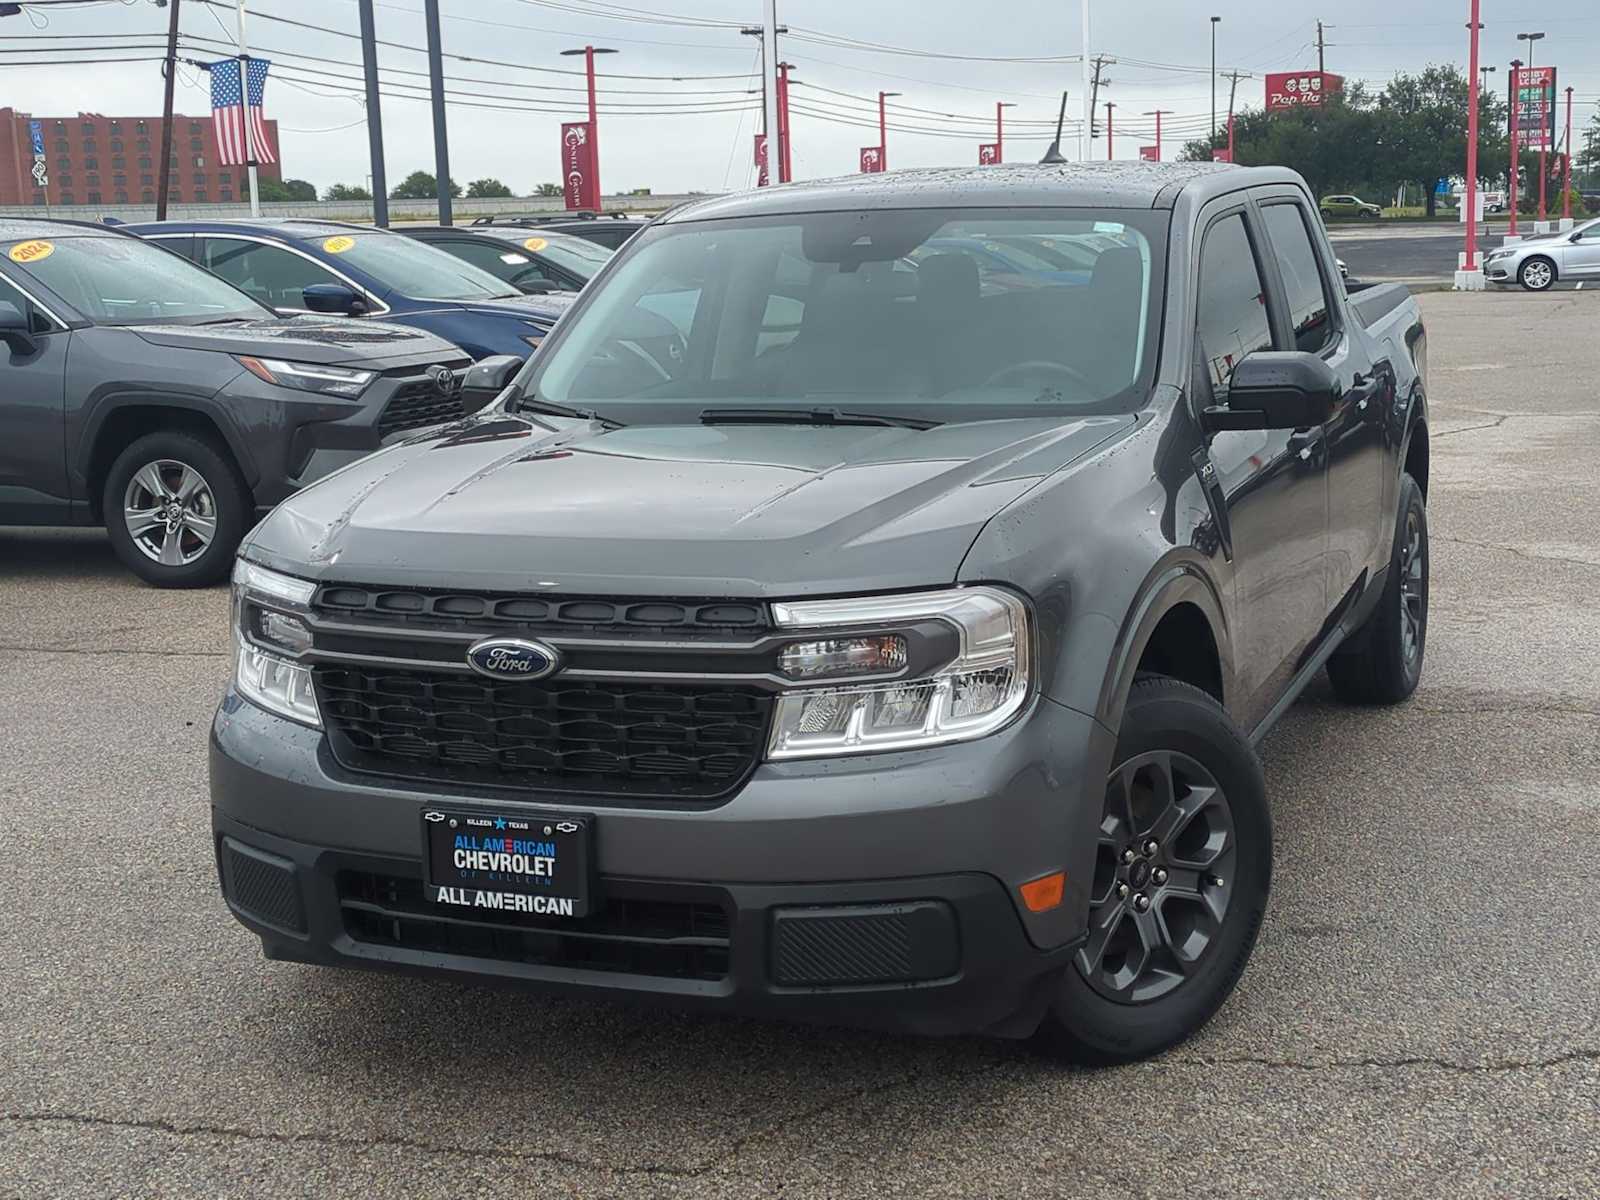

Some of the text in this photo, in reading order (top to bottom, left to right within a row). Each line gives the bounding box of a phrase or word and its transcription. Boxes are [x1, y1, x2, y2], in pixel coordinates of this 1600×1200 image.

[1271, 93, 1297, 105] Pep
[486, 648, 533, 672] Ford
[467, 818, 529, 830] KILLEEN TEXAS
[454, 835, 555, 857] ALL AMERICAN
[454, 850, 556, 877] CHEVROLET
[460, 870, 551, 886] OF KILLEEN
[437, 886, 574, 917] ALL AMERICAN
